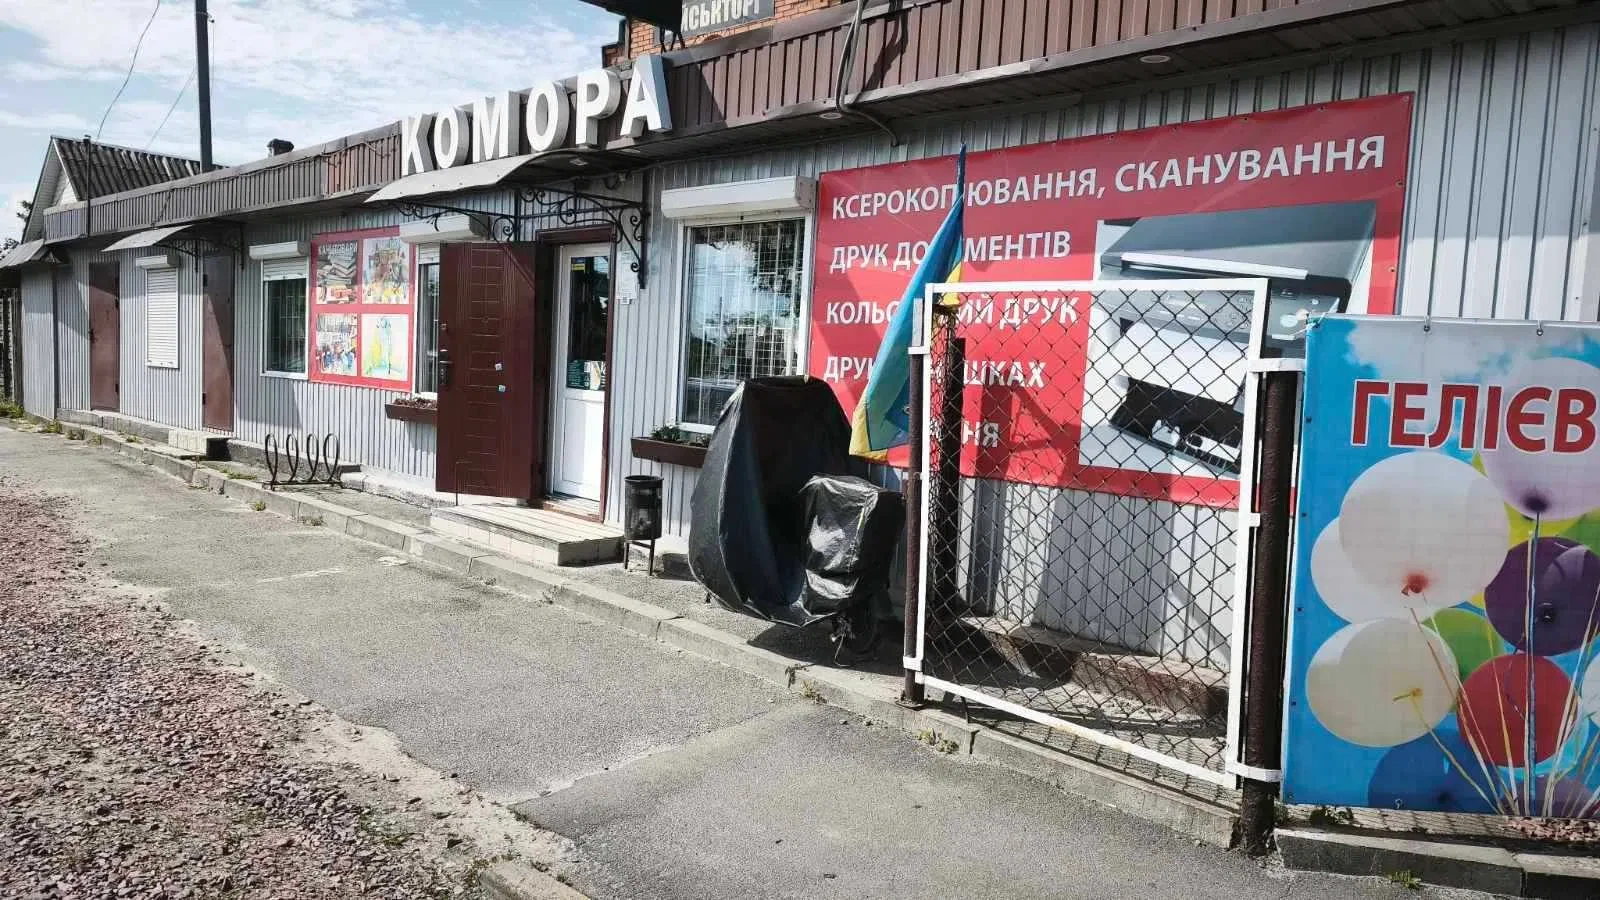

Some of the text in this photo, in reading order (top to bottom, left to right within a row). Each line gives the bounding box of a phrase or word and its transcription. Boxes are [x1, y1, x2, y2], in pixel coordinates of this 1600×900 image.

[401, 55, 672, 175] КОМОРА
[832, 135, 1385, 220] КСЕРОКОПЮВАННЯ, СКАНУВАННЯ
[829, 230, 1071, 273] ДРУК ДОМЕНТІВ
[999, 297, 1079, 330] ДРУК
[1351, 379, 1598, 454] ГЕЛІЄВ
